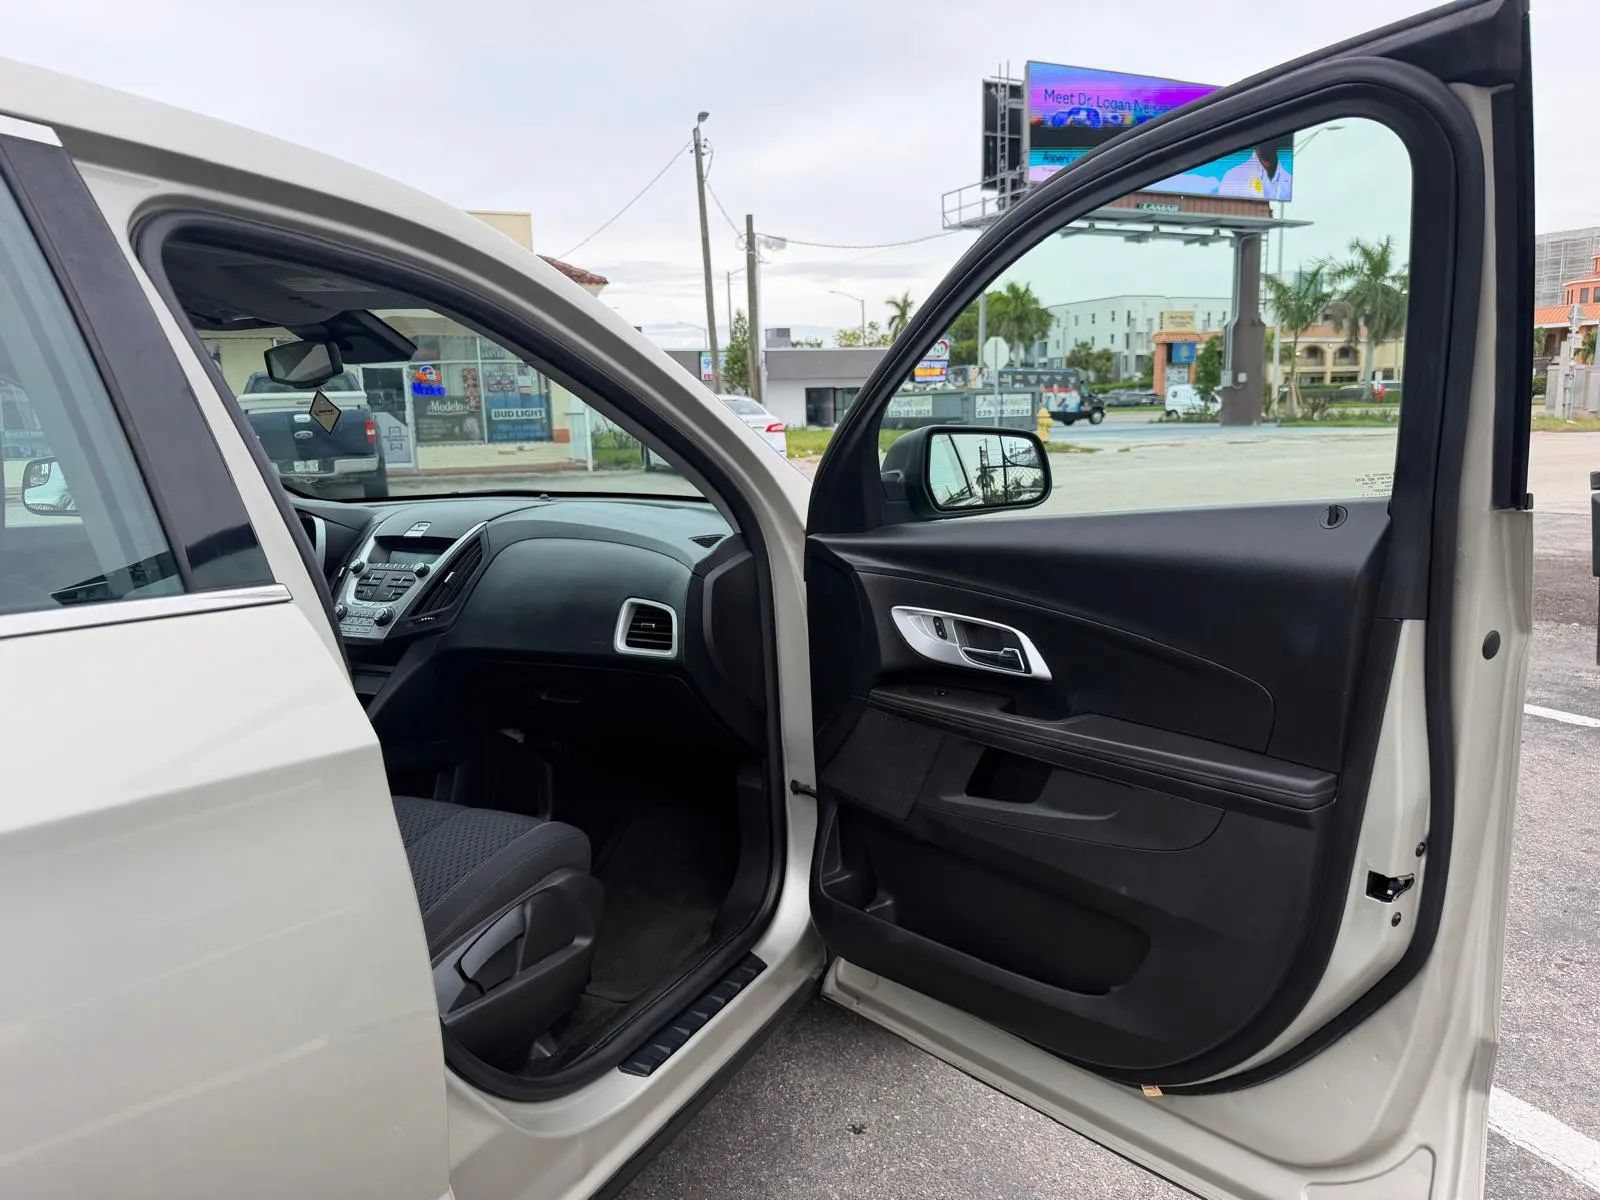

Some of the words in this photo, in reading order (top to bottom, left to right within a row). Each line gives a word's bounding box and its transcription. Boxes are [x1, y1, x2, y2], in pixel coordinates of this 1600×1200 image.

[1044, 88, 1074, 105] Meet
[1078, 92, 1092, 107] Dr.
[1096, 95, 1131, 112] Logan
[429, 399, 464, 413] Modelo
[493, 410, 514, 419] BUD
[516, 409, 543, 418] LIGHT
